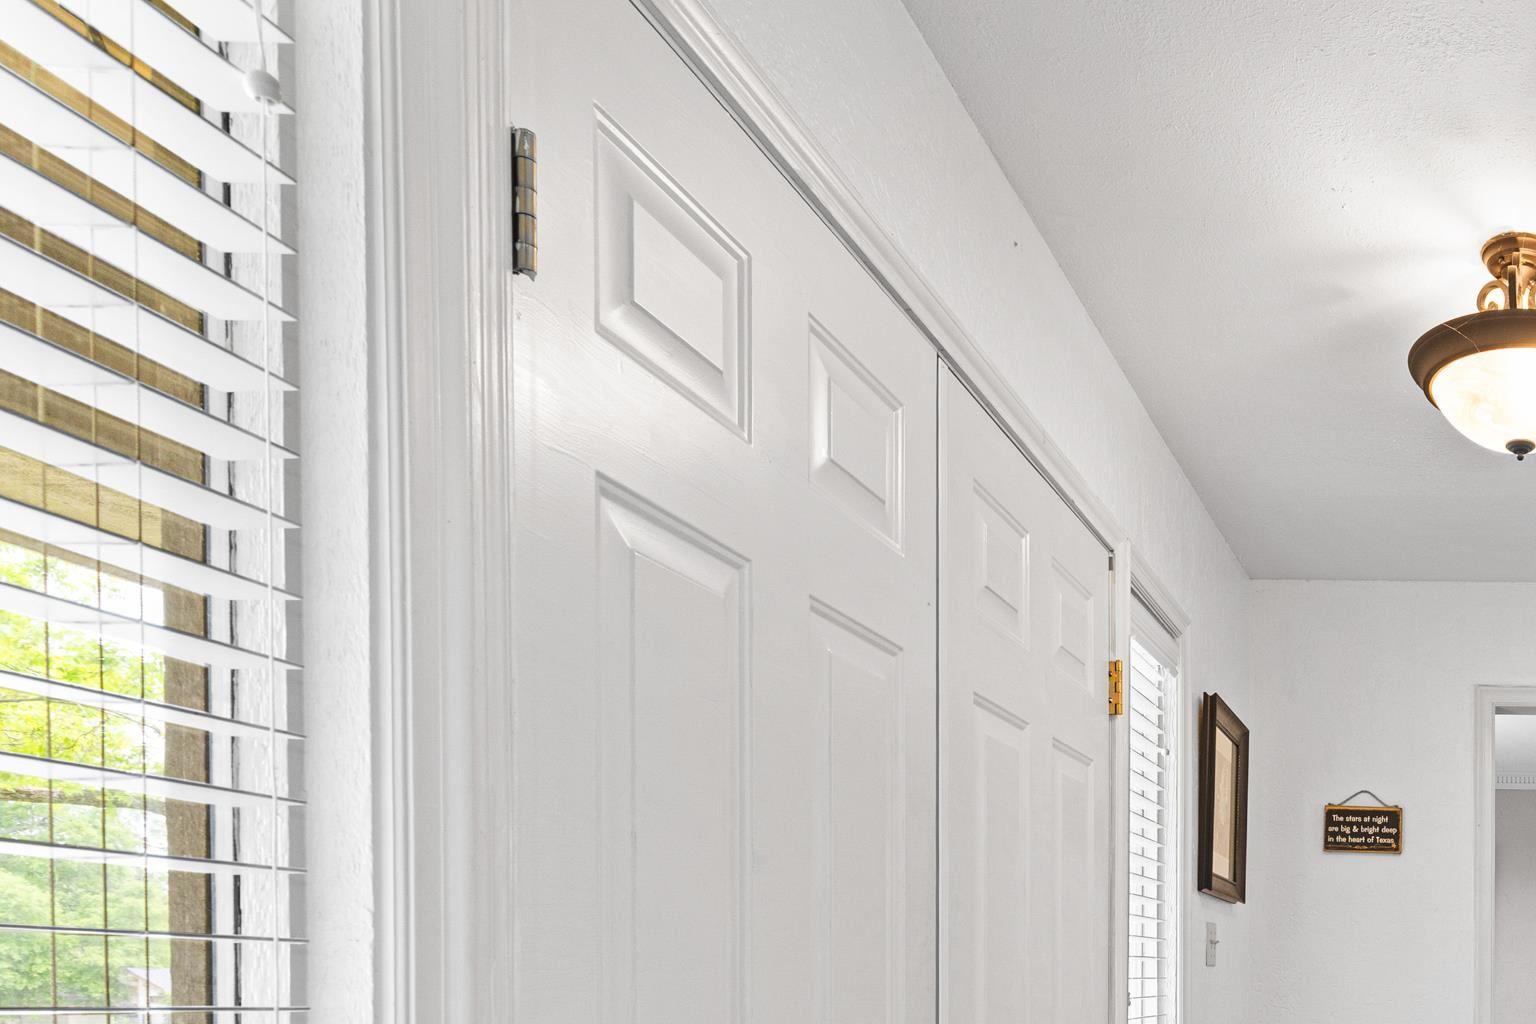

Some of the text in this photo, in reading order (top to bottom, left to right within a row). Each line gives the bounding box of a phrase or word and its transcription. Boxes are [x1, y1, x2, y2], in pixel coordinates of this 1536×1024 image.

[1332, 814, 1344, 822] The
[1372, 815, 1388, 824] night
[1341, 825, 1350, 833] big
[1361, 826, 1379, 834] bright
[1381, 826, 1397, 835] deep
